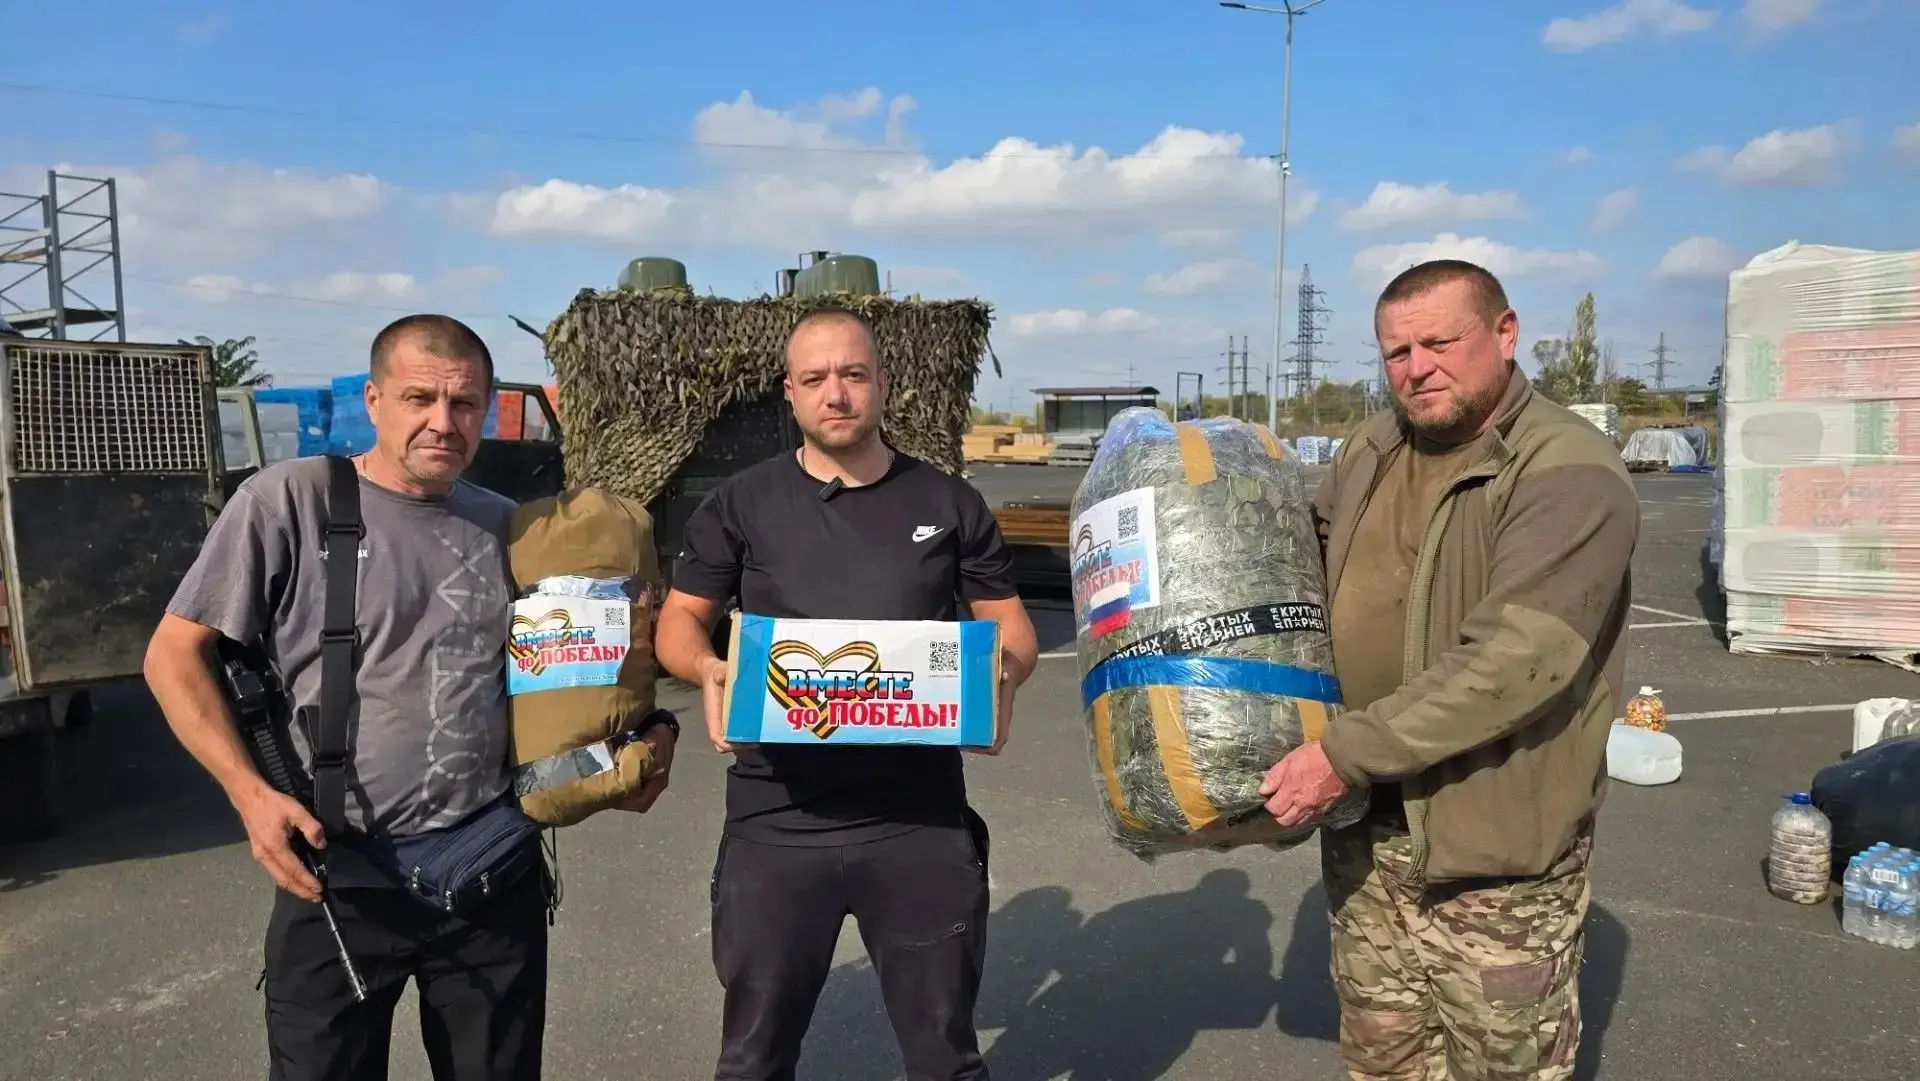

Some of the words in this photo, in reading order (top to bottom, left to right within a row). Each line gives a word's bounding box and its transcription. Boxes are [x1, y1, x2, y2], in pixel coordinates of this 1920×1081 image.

[916, 525, 937, 536] NIKE
[1188, 611, 1251, 637] КРУТЫХ
[1280, 605, 1322, 618] КРУТЫХ
[515, 626, 596, 652] ВМЕСТЕ
[517, 656, 534, 672] до
[540, 645, 626, 666] ПОБЕДЫ!
[786, 669, 914, 700] ВМЕСТЕ
[787, 708, 818, 730] до
[829, 702, 958, 728] ПОБЕДЫ!
